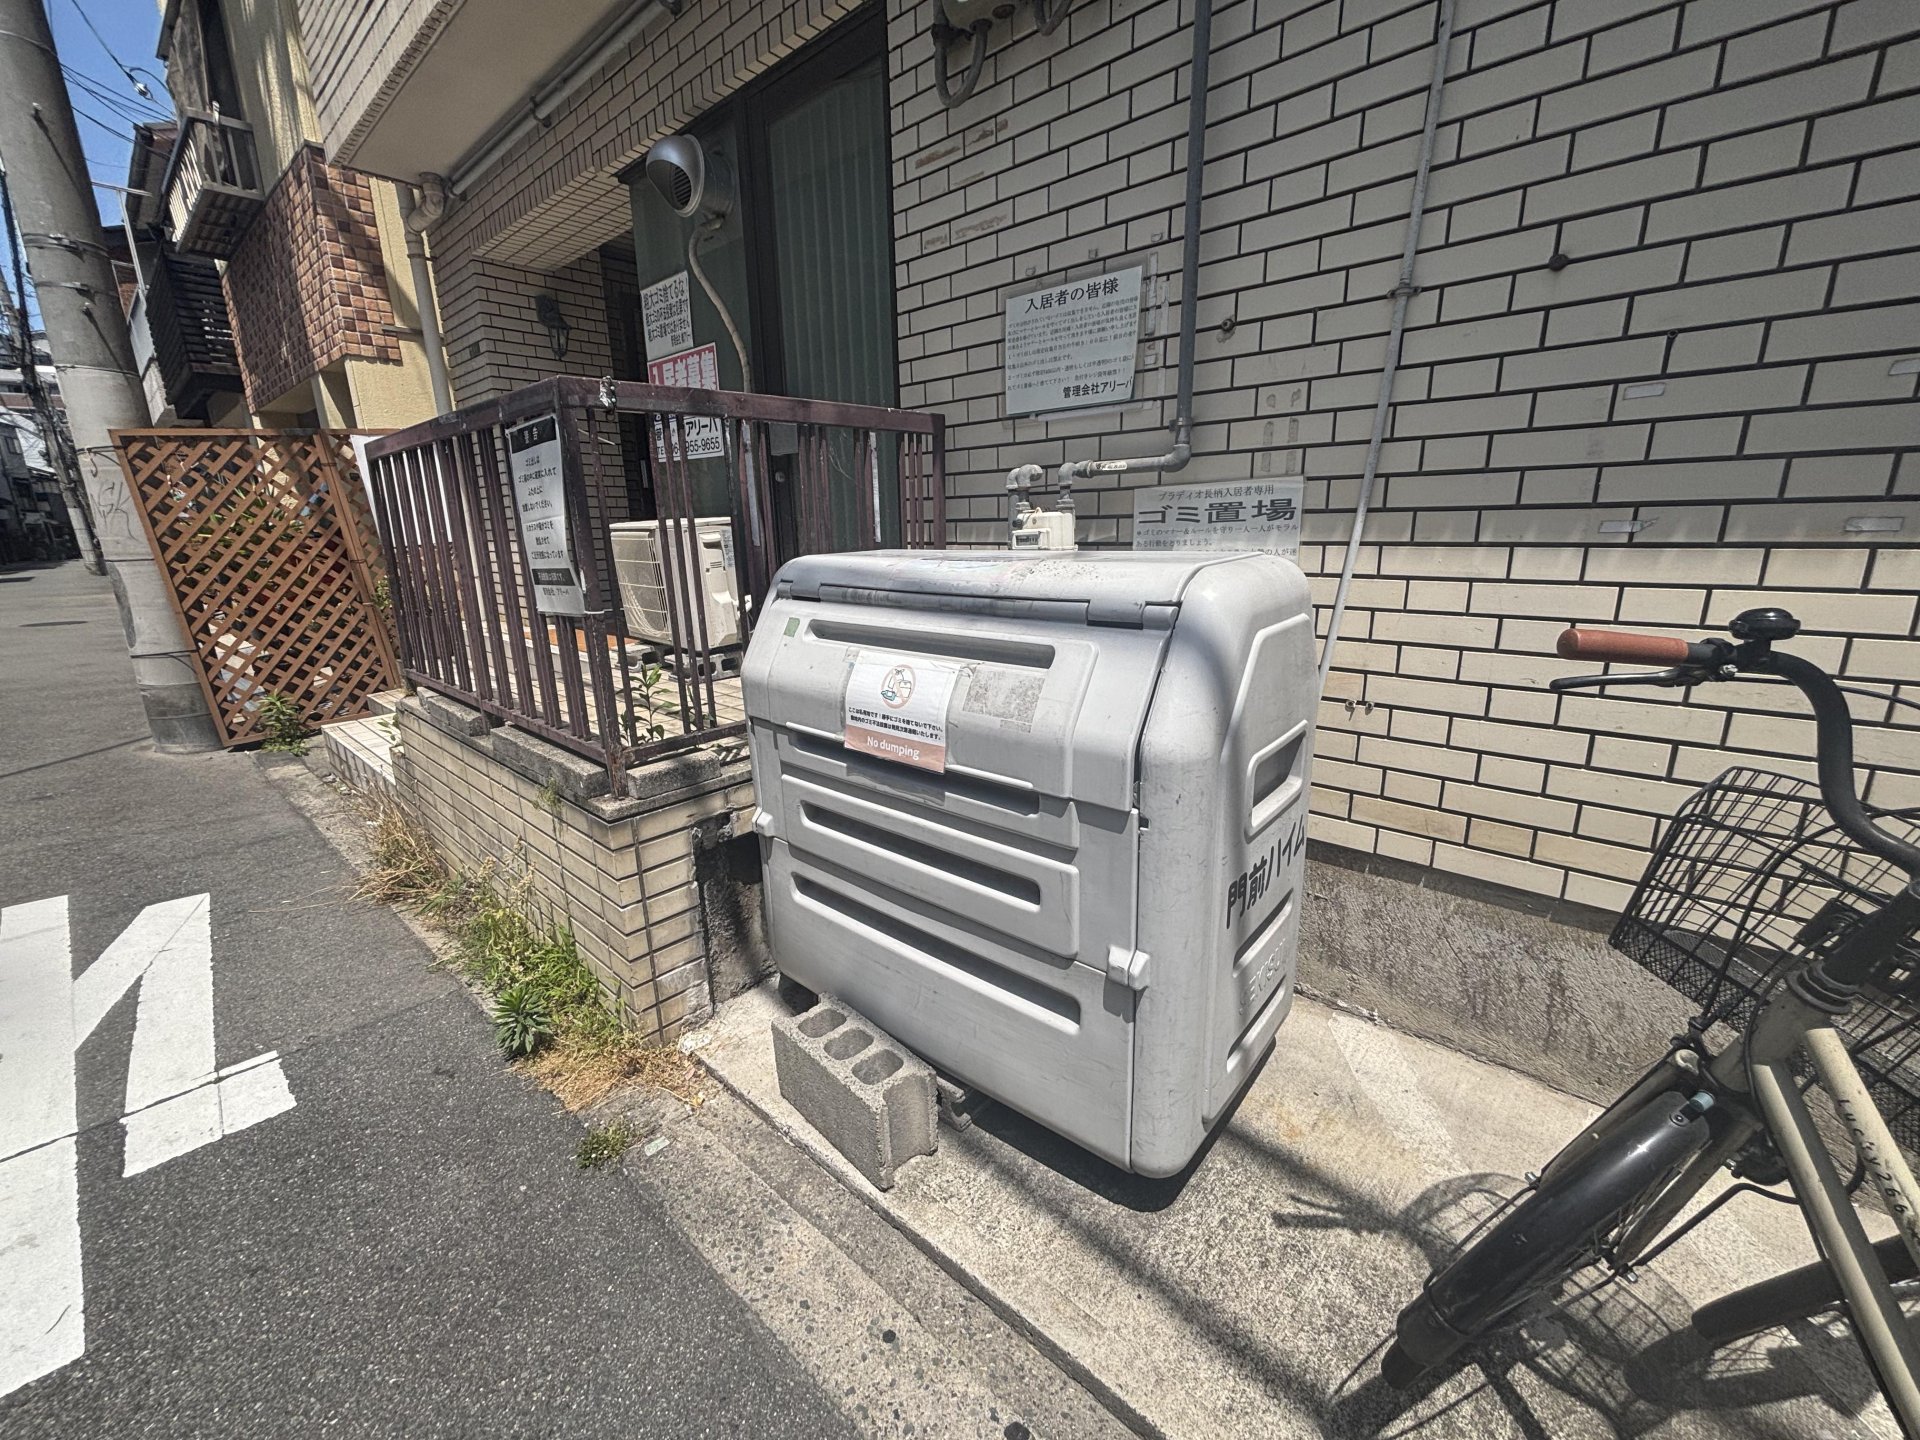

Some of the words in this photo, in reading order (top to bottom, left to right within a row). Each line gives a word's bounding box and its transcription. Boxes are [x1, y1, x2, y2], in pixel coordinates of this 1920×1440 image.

[1025, 277, 1119, 314] 入居者の皆様
[1138, 498, 1297, 524] ゴミ置場
[867, 735, 879, 748] No
[879, 738, 920, 761] dumping
[1226, 814, 1305, 929] 門前ハイム
